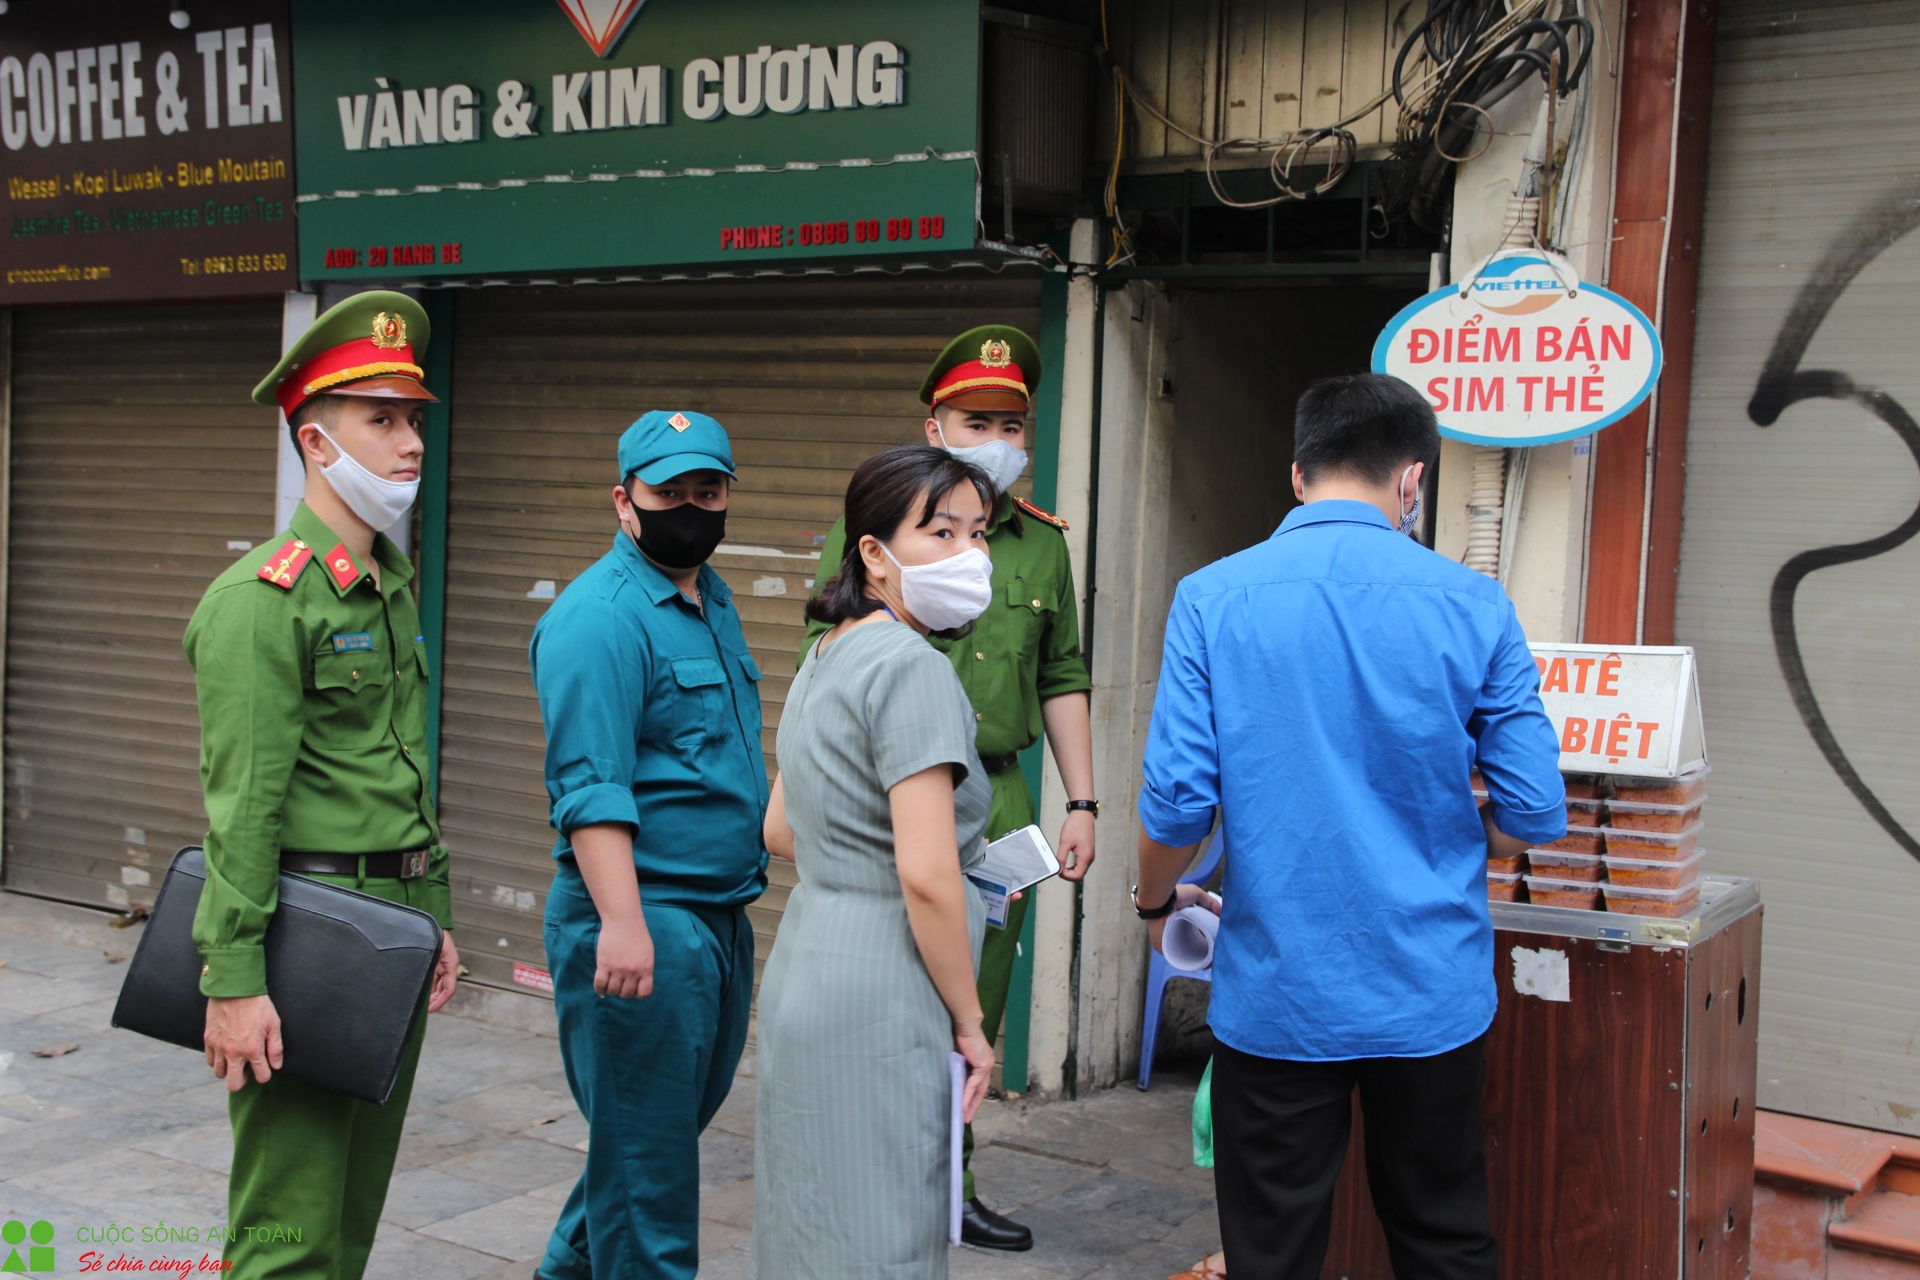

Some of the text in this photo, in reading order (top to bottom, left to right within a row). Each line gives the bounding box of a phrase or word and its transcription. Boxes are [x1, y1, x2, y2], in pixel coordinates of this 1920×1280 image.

[0, 23, 283, 150] COFFEE & TEA
[337, 40, 904, 150] VÀNG & KIM CƯƠNG
[73, 169, 109, 199] Kopi
[112, 166, 164, 193] Luwak
[177, 161, 214, 188] Blue
[218, 155, 285, 183] Moutain
[73, 209, 99, 234] Tea
[110, 206, 199, 231] Vietnamese
[204, 200, 250, 226] Green
[254, 196, 283, 221] Tea
[799, 221, 848, 246] 0886
[855, 219, 880, 243] 89
[886, 217, 911, 241] 89
[918, 215, 944, 239] 89
[237, 254, 260, 272] 633
[263, 253, 287, 271] 630
[368, 246, 387, 267] 20
[392, 243, 435, 265] HANG
[441, 242, 462, 264] BE
[1407, 314, 1632, 364] ĐIỂM BÁN
[1426, 363, 1605, 413] SIM THẺ
[1560, 712, 1659, 764] BIỆT
